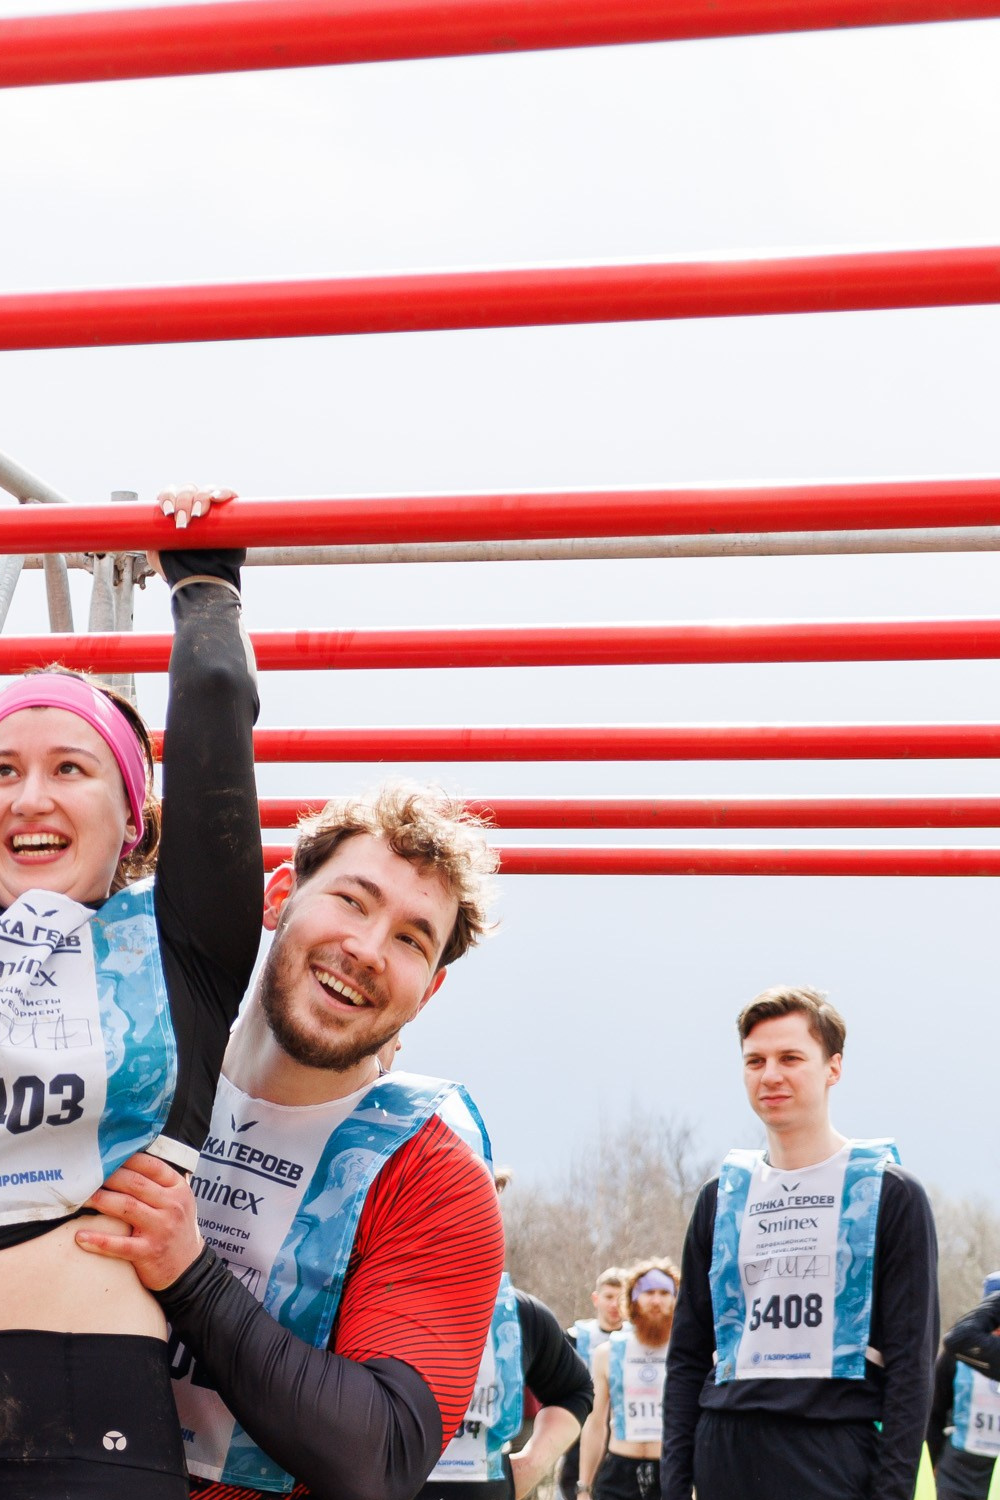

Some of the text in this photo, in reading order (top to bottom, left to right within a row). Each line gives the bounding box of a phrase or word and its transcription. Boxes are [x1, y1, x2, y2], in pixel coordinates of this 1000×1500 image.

[227, 1142, 304, 1181] ГЕРОЕВ
[190, 1176, 265, 1216] minex
[750, 1195, 835, 1213] ГОНКА ГЕРОЕВ
[198, 1217, 251, 1240] ЦИОНИСТЫ
[758, 1216, 820, 1235] Sminex
[205, 1237, 246, 1255] OPMENT
[749, 1292, 823, 1332] 5408
[764, 1352, 811, 1361] ГАЗПРОМБАНК
